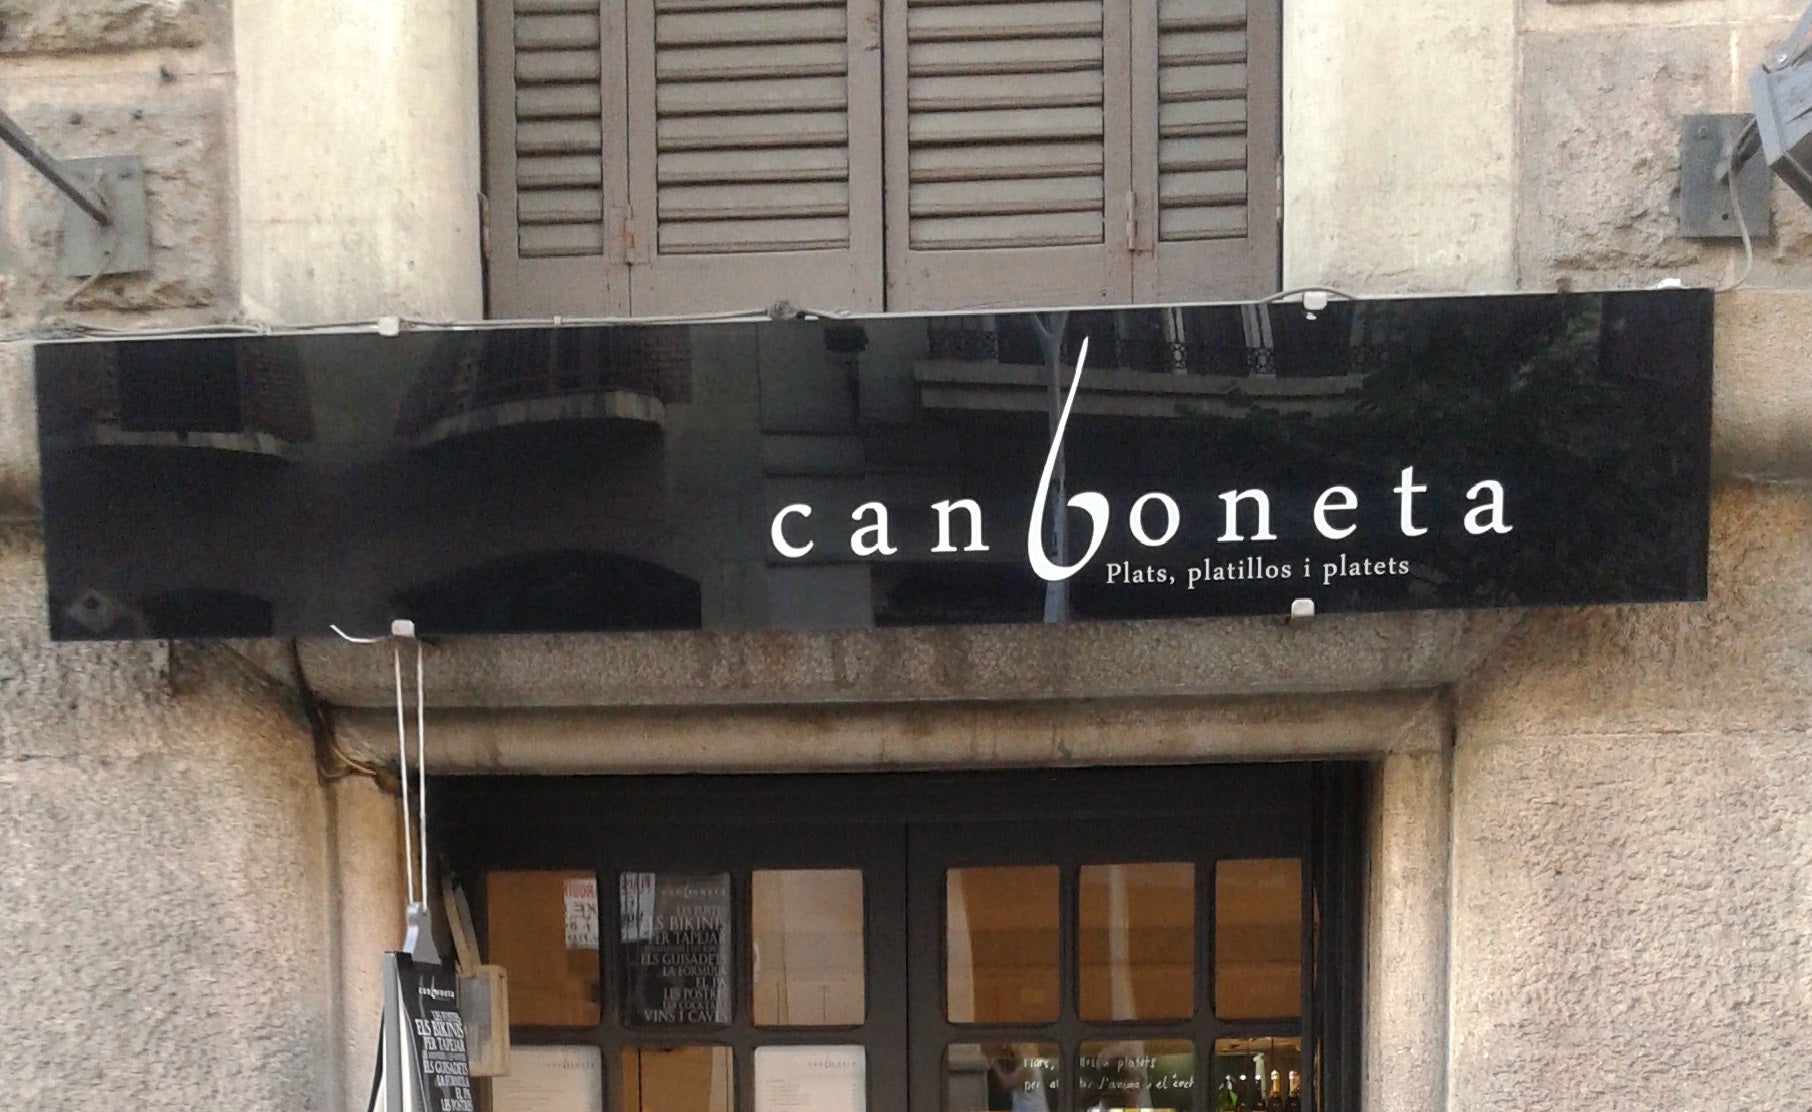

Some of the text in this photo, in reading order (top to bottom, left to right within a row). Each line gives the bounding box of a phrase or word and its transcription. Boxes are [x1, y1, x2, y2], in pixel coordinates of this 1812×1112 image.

[1106, 553, 1411, 589] Plats, platillos i platets
[670, 916, 727, 931] BIKINIS
[644, 1009, 675, 1022] VINS
[415, 1018, 464, 1039] ELS BIKINIS
